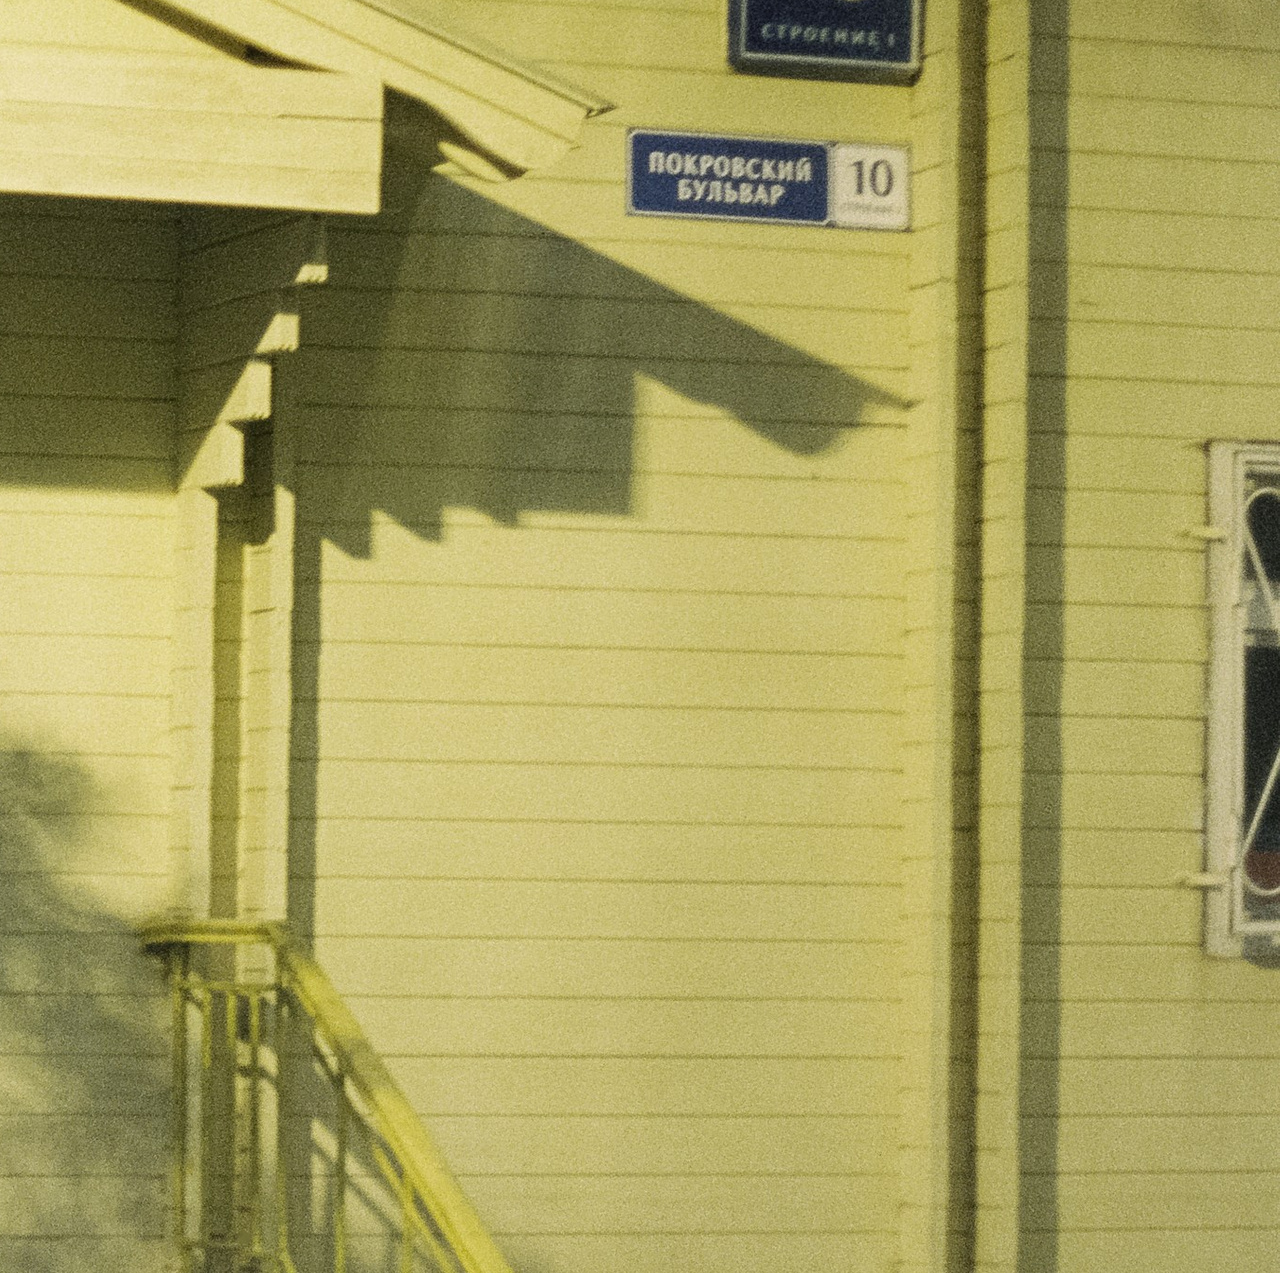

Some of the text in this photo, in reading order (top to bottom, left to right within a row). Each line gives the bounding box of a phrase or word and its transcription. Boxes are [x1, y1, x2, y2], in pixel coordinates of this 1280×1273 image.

[761, 23, 879, 47] СТРОЕНИЕ
[648, 150, 812, 183] ПОКРОВСКИЙ
[850, 159, 894, 197] 10
[677, 179, 786, 206] БУЛЬВАР
